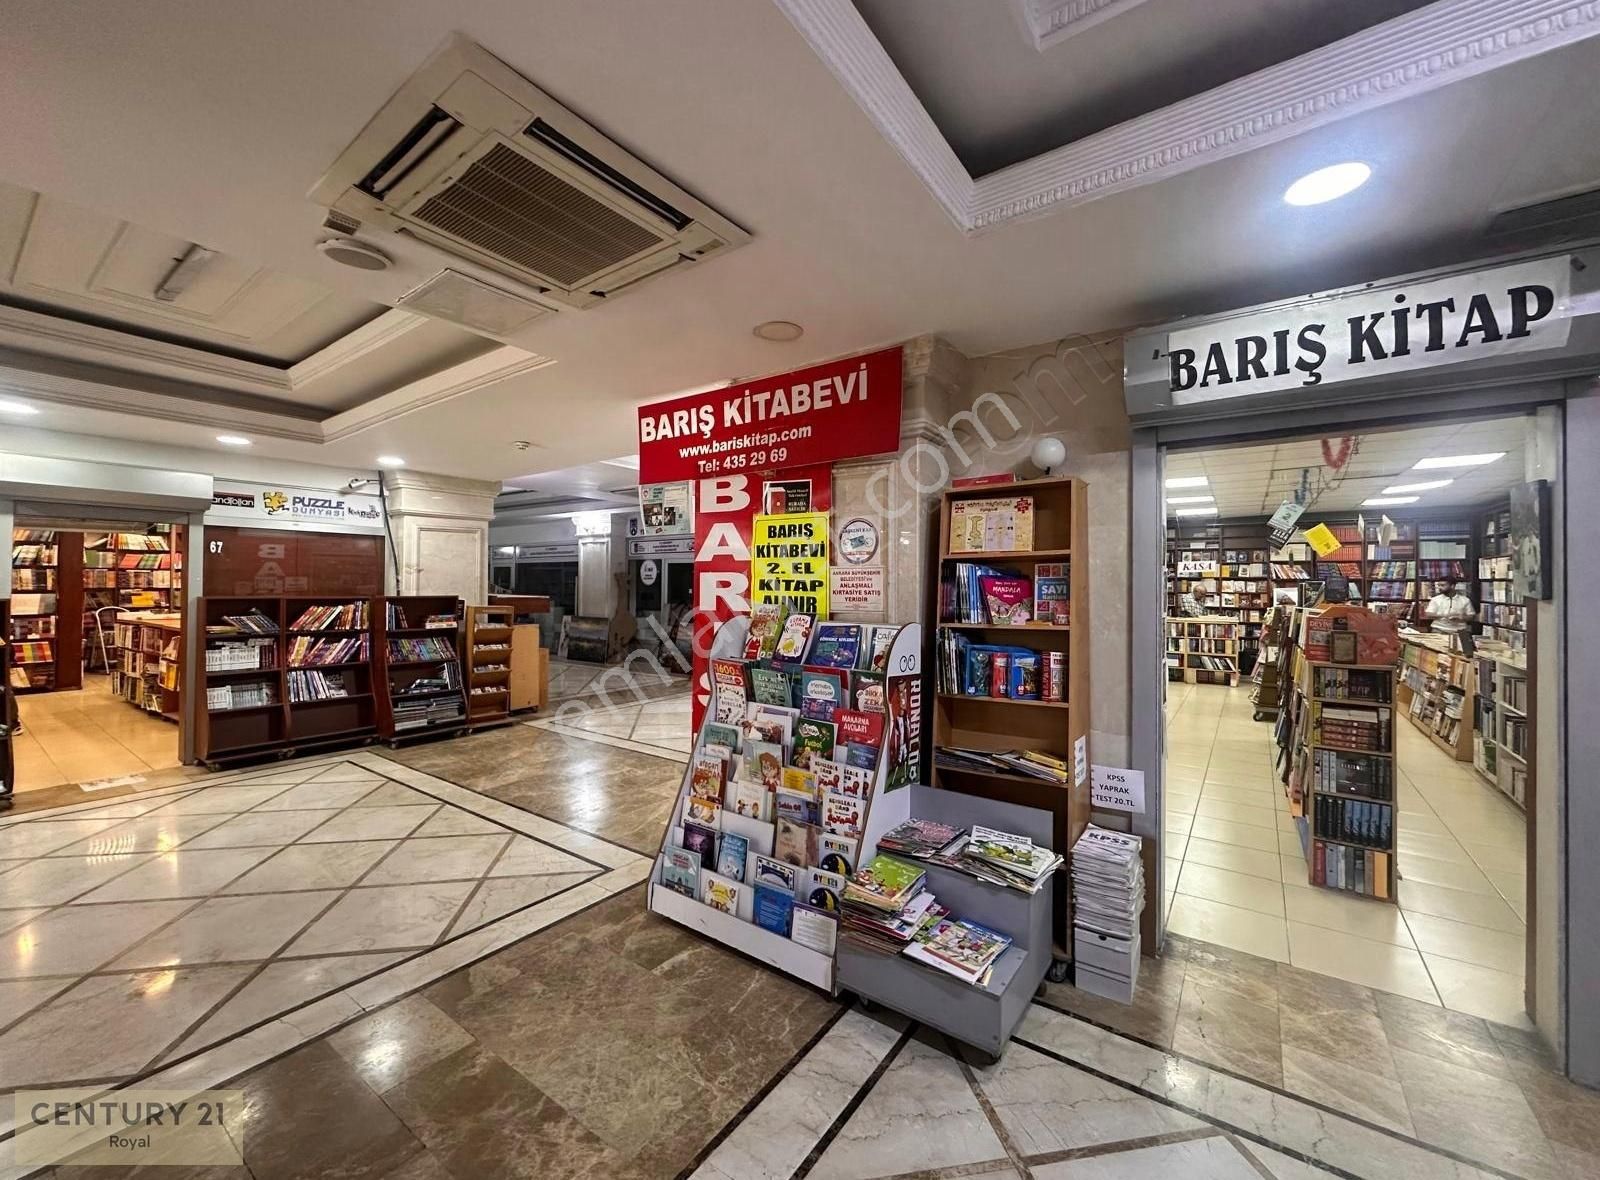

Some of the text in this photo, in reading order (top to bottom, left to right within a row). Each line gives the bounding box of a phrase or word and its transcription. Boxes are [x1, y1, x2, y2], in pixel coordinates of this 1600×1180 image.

[1169, 284, 1555, 393] BARIŞ KİTAP
[641, 362, 868, 443] BARIŞ KİTABEVİ
[679, 425, 812, 458] www.bariskitap.com
[698, 447, 788, 473] Tel: 435 29 69
[292, 496, 345, 510] PUZZLE
[767, 523, 814, 540] BARIŞ
[209, 541, 223, 554] 67
[756, 541, 826, 558] KİTABEVİ
[766, 562, 815, 574] 2. EL
[1182, 562, 1212, 572] KASA
[758, 577, 824, 592] KİTAP
[840, 582, 873, 590] ANLAŞMALI
[842, 715, 870, 726] MAKARNA
[1107, 774, 1125, 782] KPSS
[1099, 784, 1130, 794] YAPRAK
[1096, 794, 1135, 806] TEST 20.TL
[1088, 832, 1130, 846] KPSS
